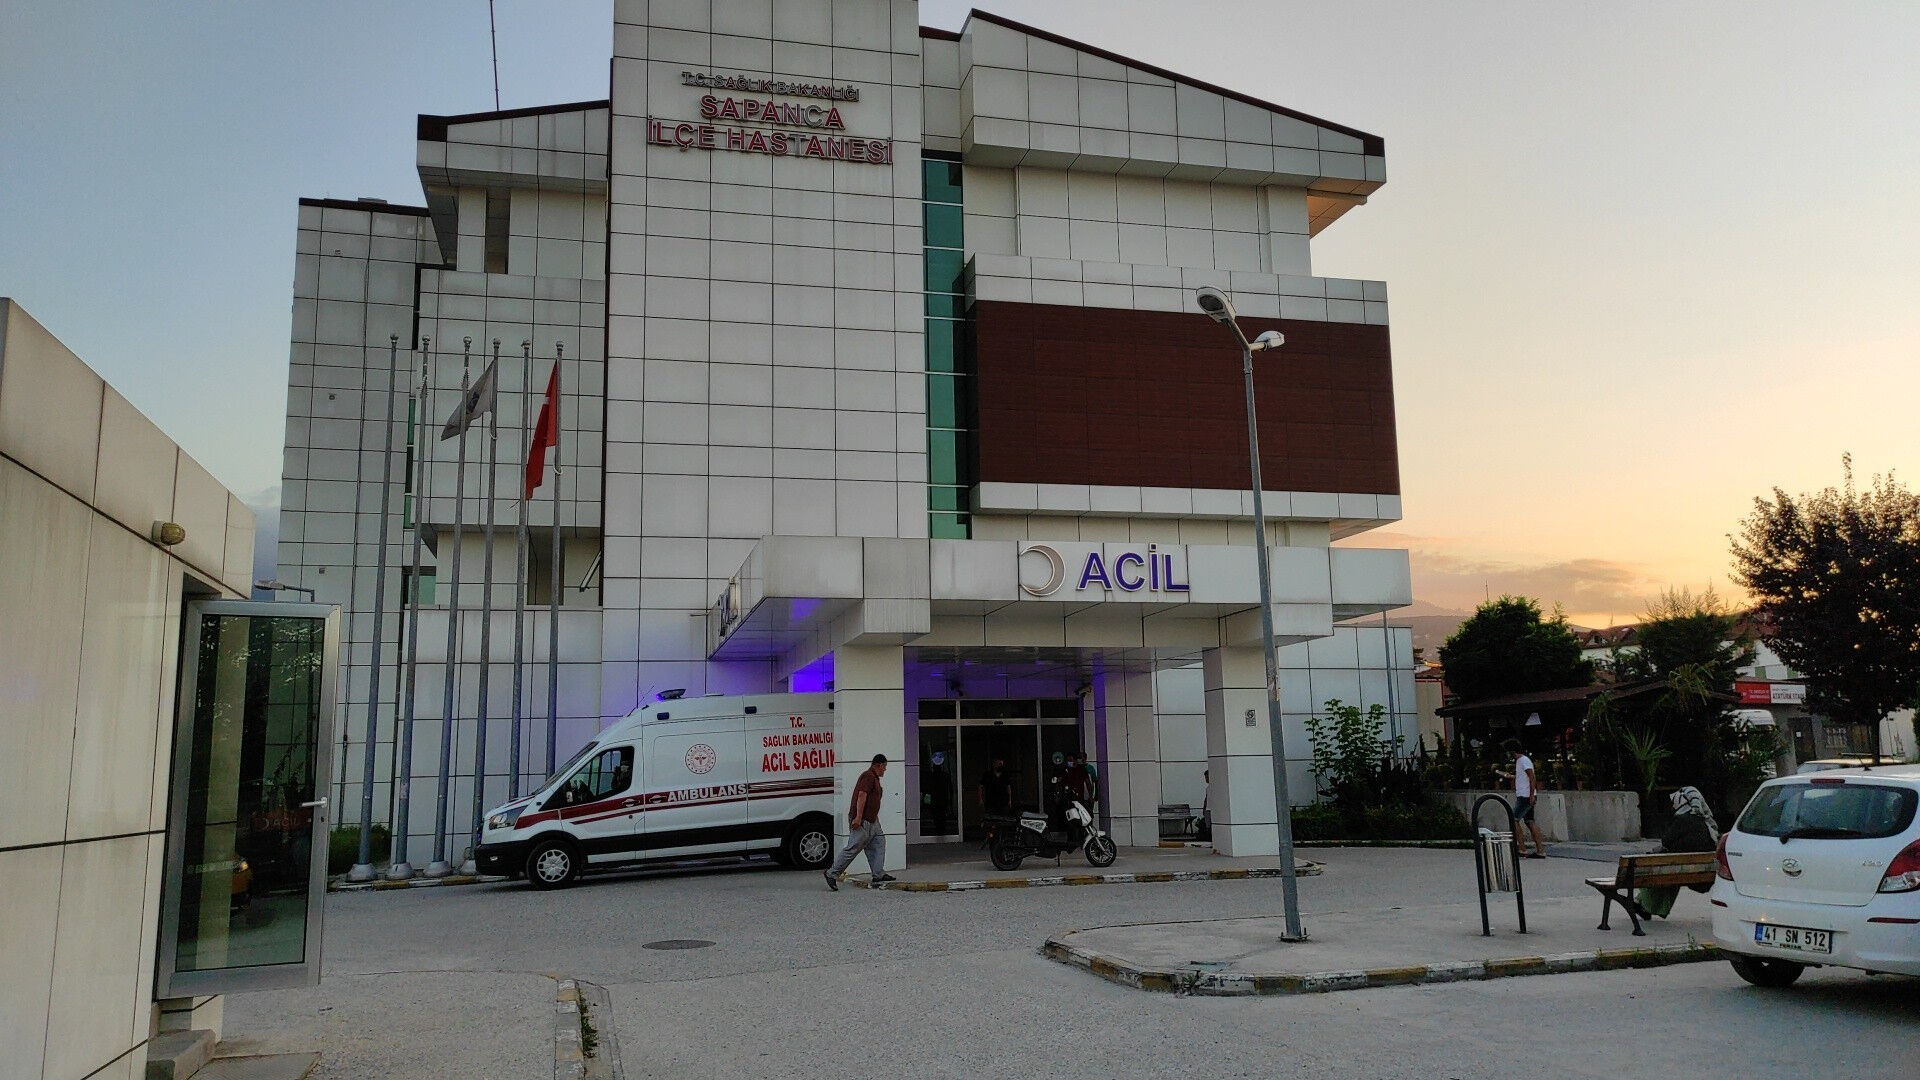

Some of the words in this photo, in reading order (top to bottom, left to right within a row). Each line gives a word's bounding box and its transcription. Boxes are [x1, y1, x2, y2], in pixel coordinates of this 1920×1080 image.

[714, 75, 772, 93] SAĞLIK
[777, 81, 860, 101] BAKANLIĞI
[699, 94, 845, 130] SAPANCA
[647, 115, 715, 149] İLÇE
[726, 128, 893, 165] HASTANESİ
[1077, 543, 1190, 592] ACİL
[789, 716, 806, 728] T.C.
[667, 784, 747, 802] AMBULANS
[1765, 927, 1776, 941] 41
[1785, 929, 1799, 943] SN
[1804, 931, 1826, 947] 512
